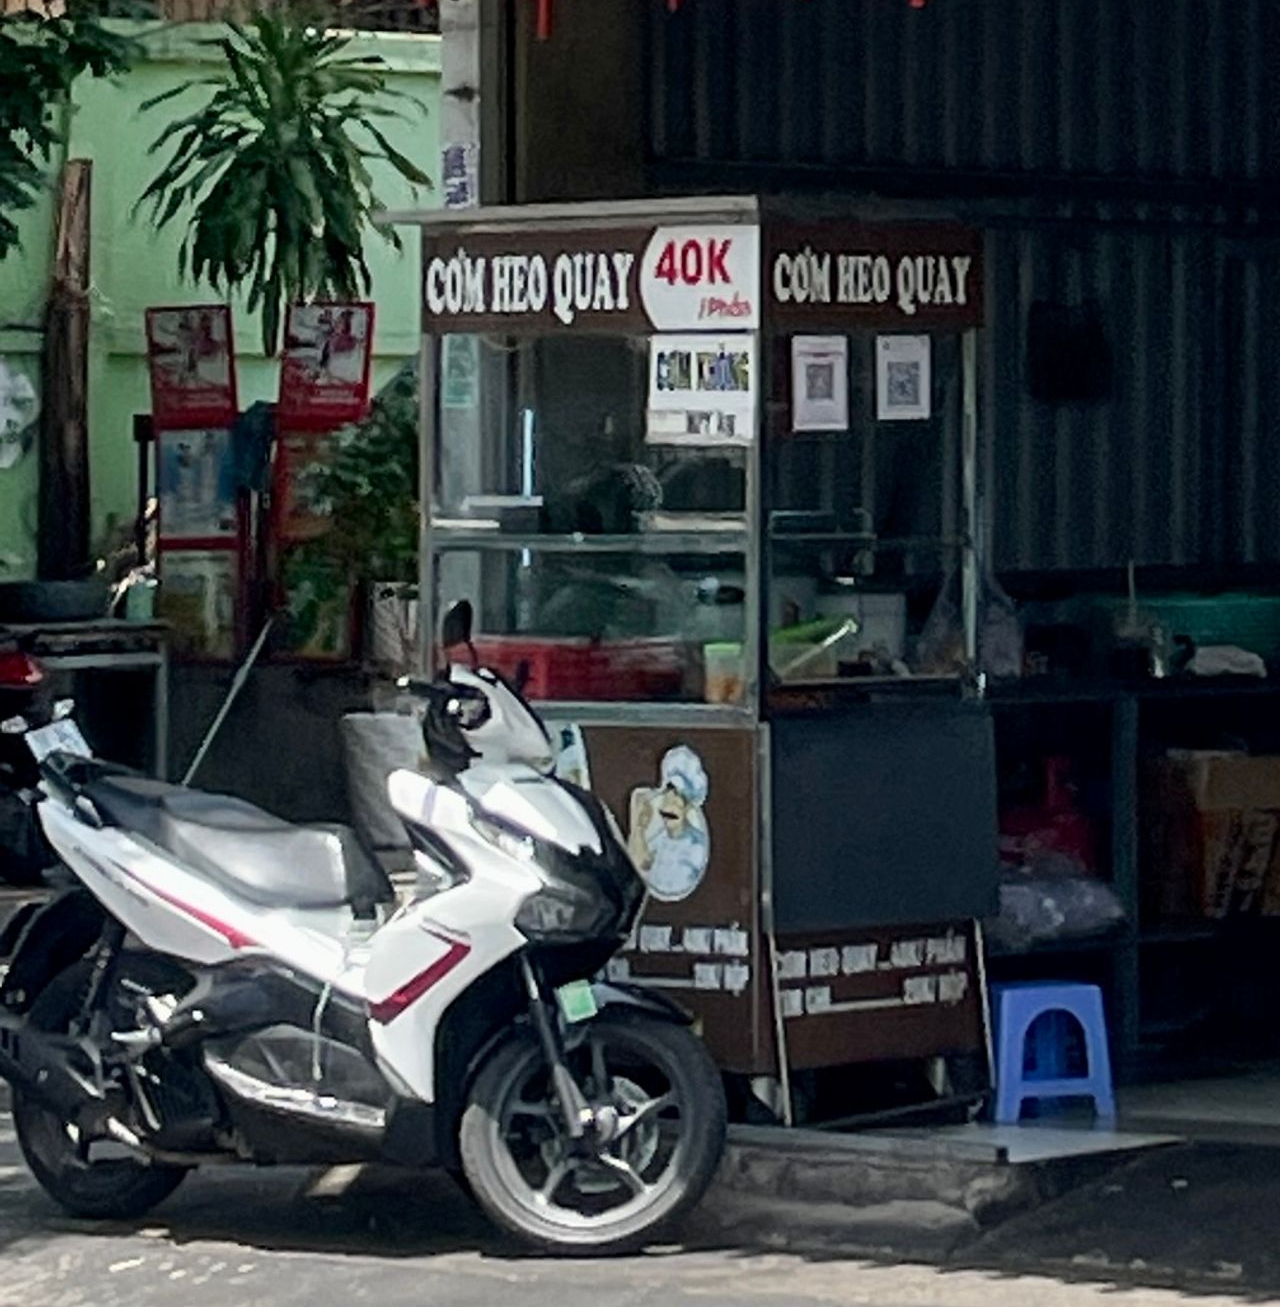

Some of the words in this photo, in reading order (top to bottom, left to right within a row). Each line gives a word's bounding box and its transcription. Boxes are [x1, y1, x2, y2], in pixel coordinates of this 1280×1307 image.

[491, 254, 548, 313] HEO
[553, 253, 635, 325] QUAY
[654, 239, 733, 286] 40K
[837, 254, 891, 304] HEO
[897, 254, 972, 316] QUAY
